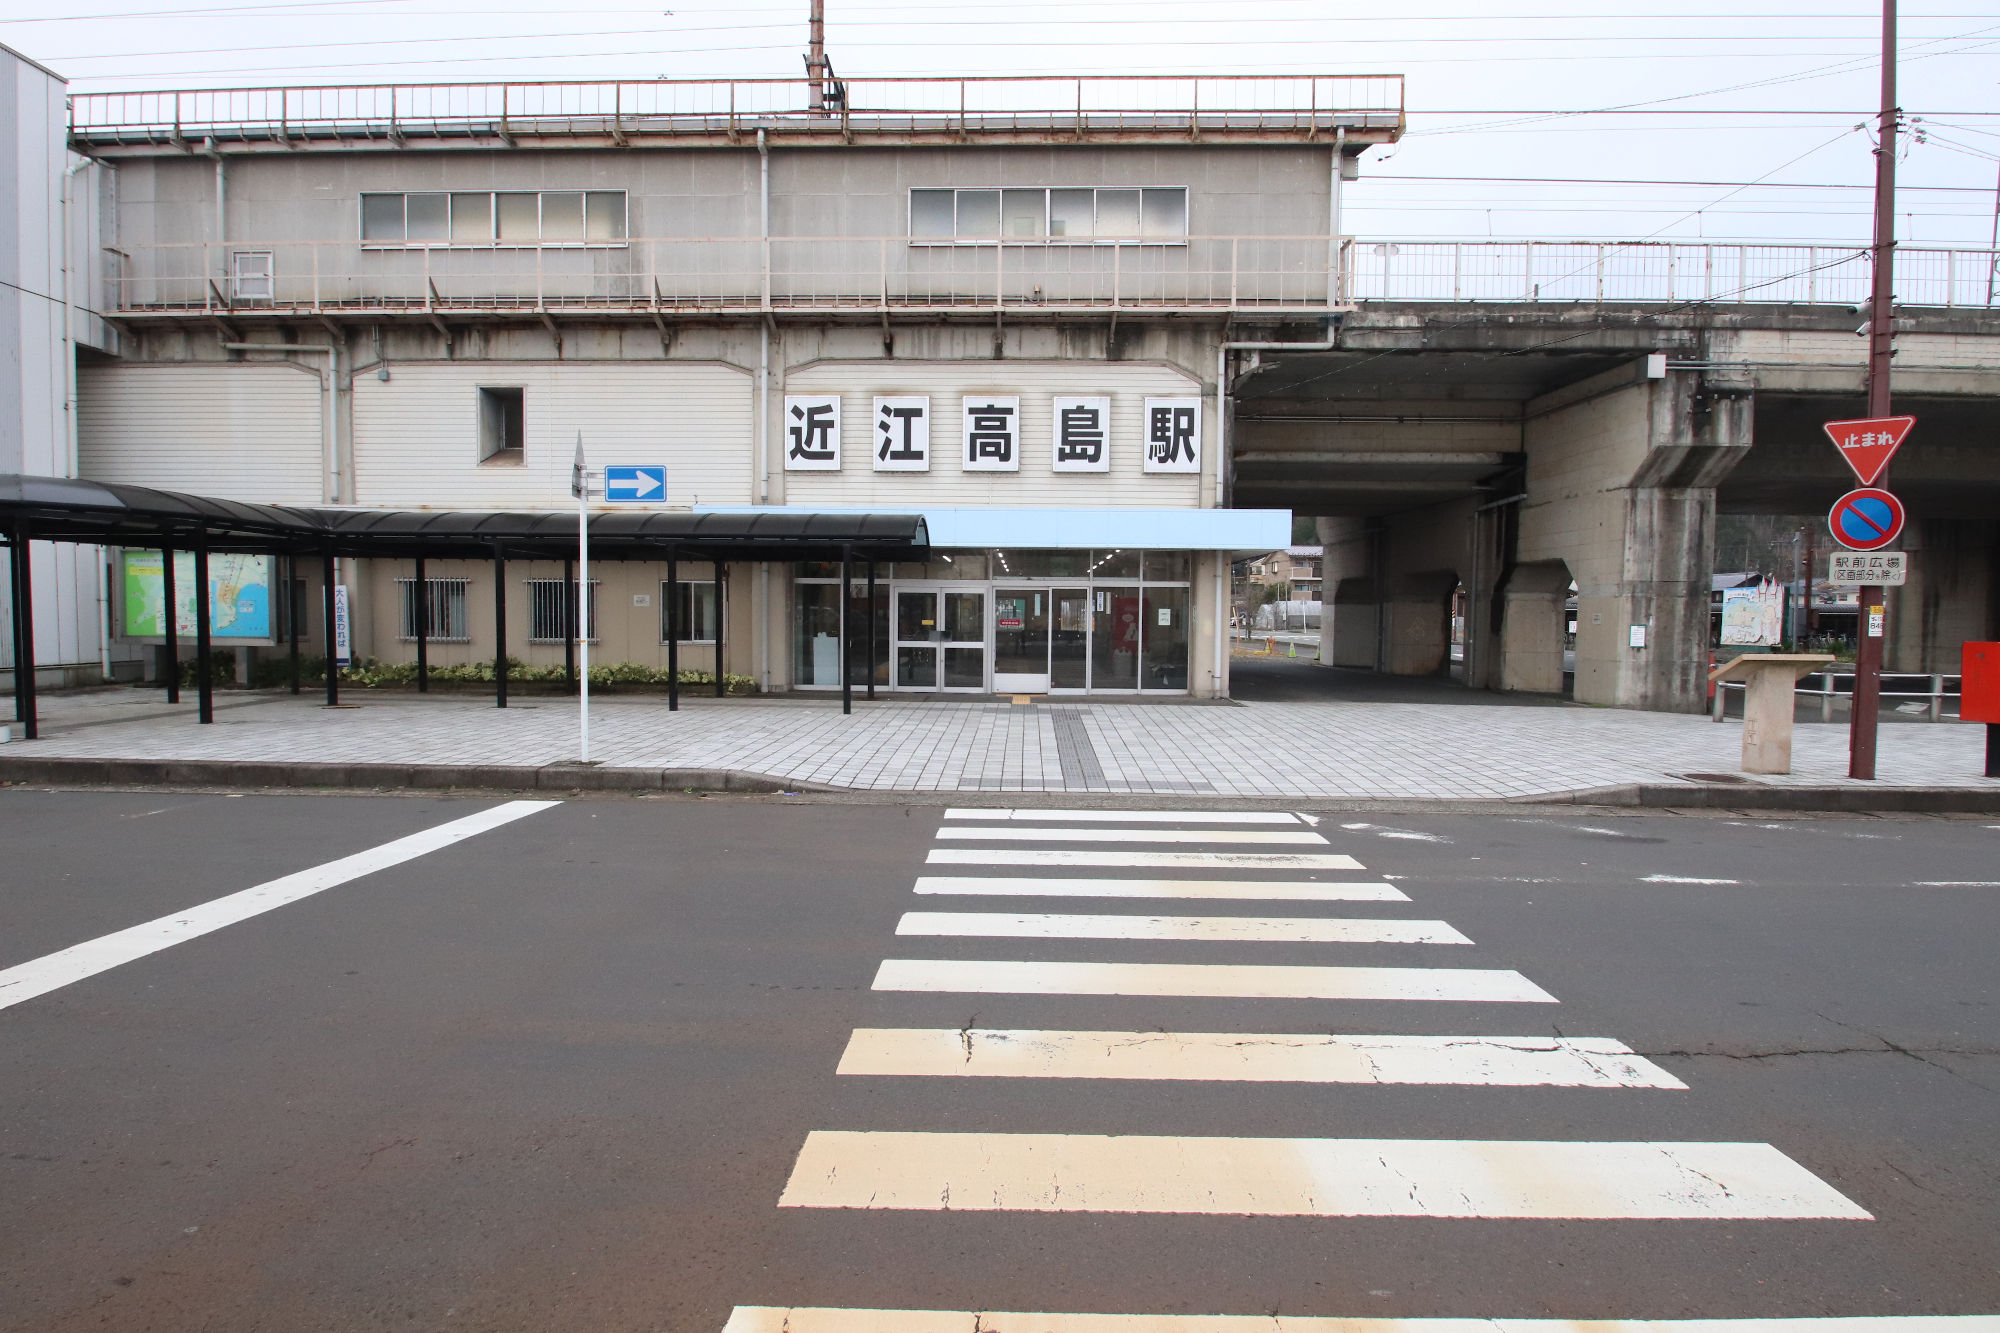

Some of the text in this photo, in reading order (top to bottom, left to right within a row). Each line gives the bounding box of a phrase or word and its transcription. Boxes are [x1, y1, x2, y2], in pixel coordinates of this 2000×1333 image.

[789, 404, 1196, 464] 近江高島駅
[1842, 431, 1894, 449] 止まれ
[1835, 557, 1900, 568] 駅前広場
